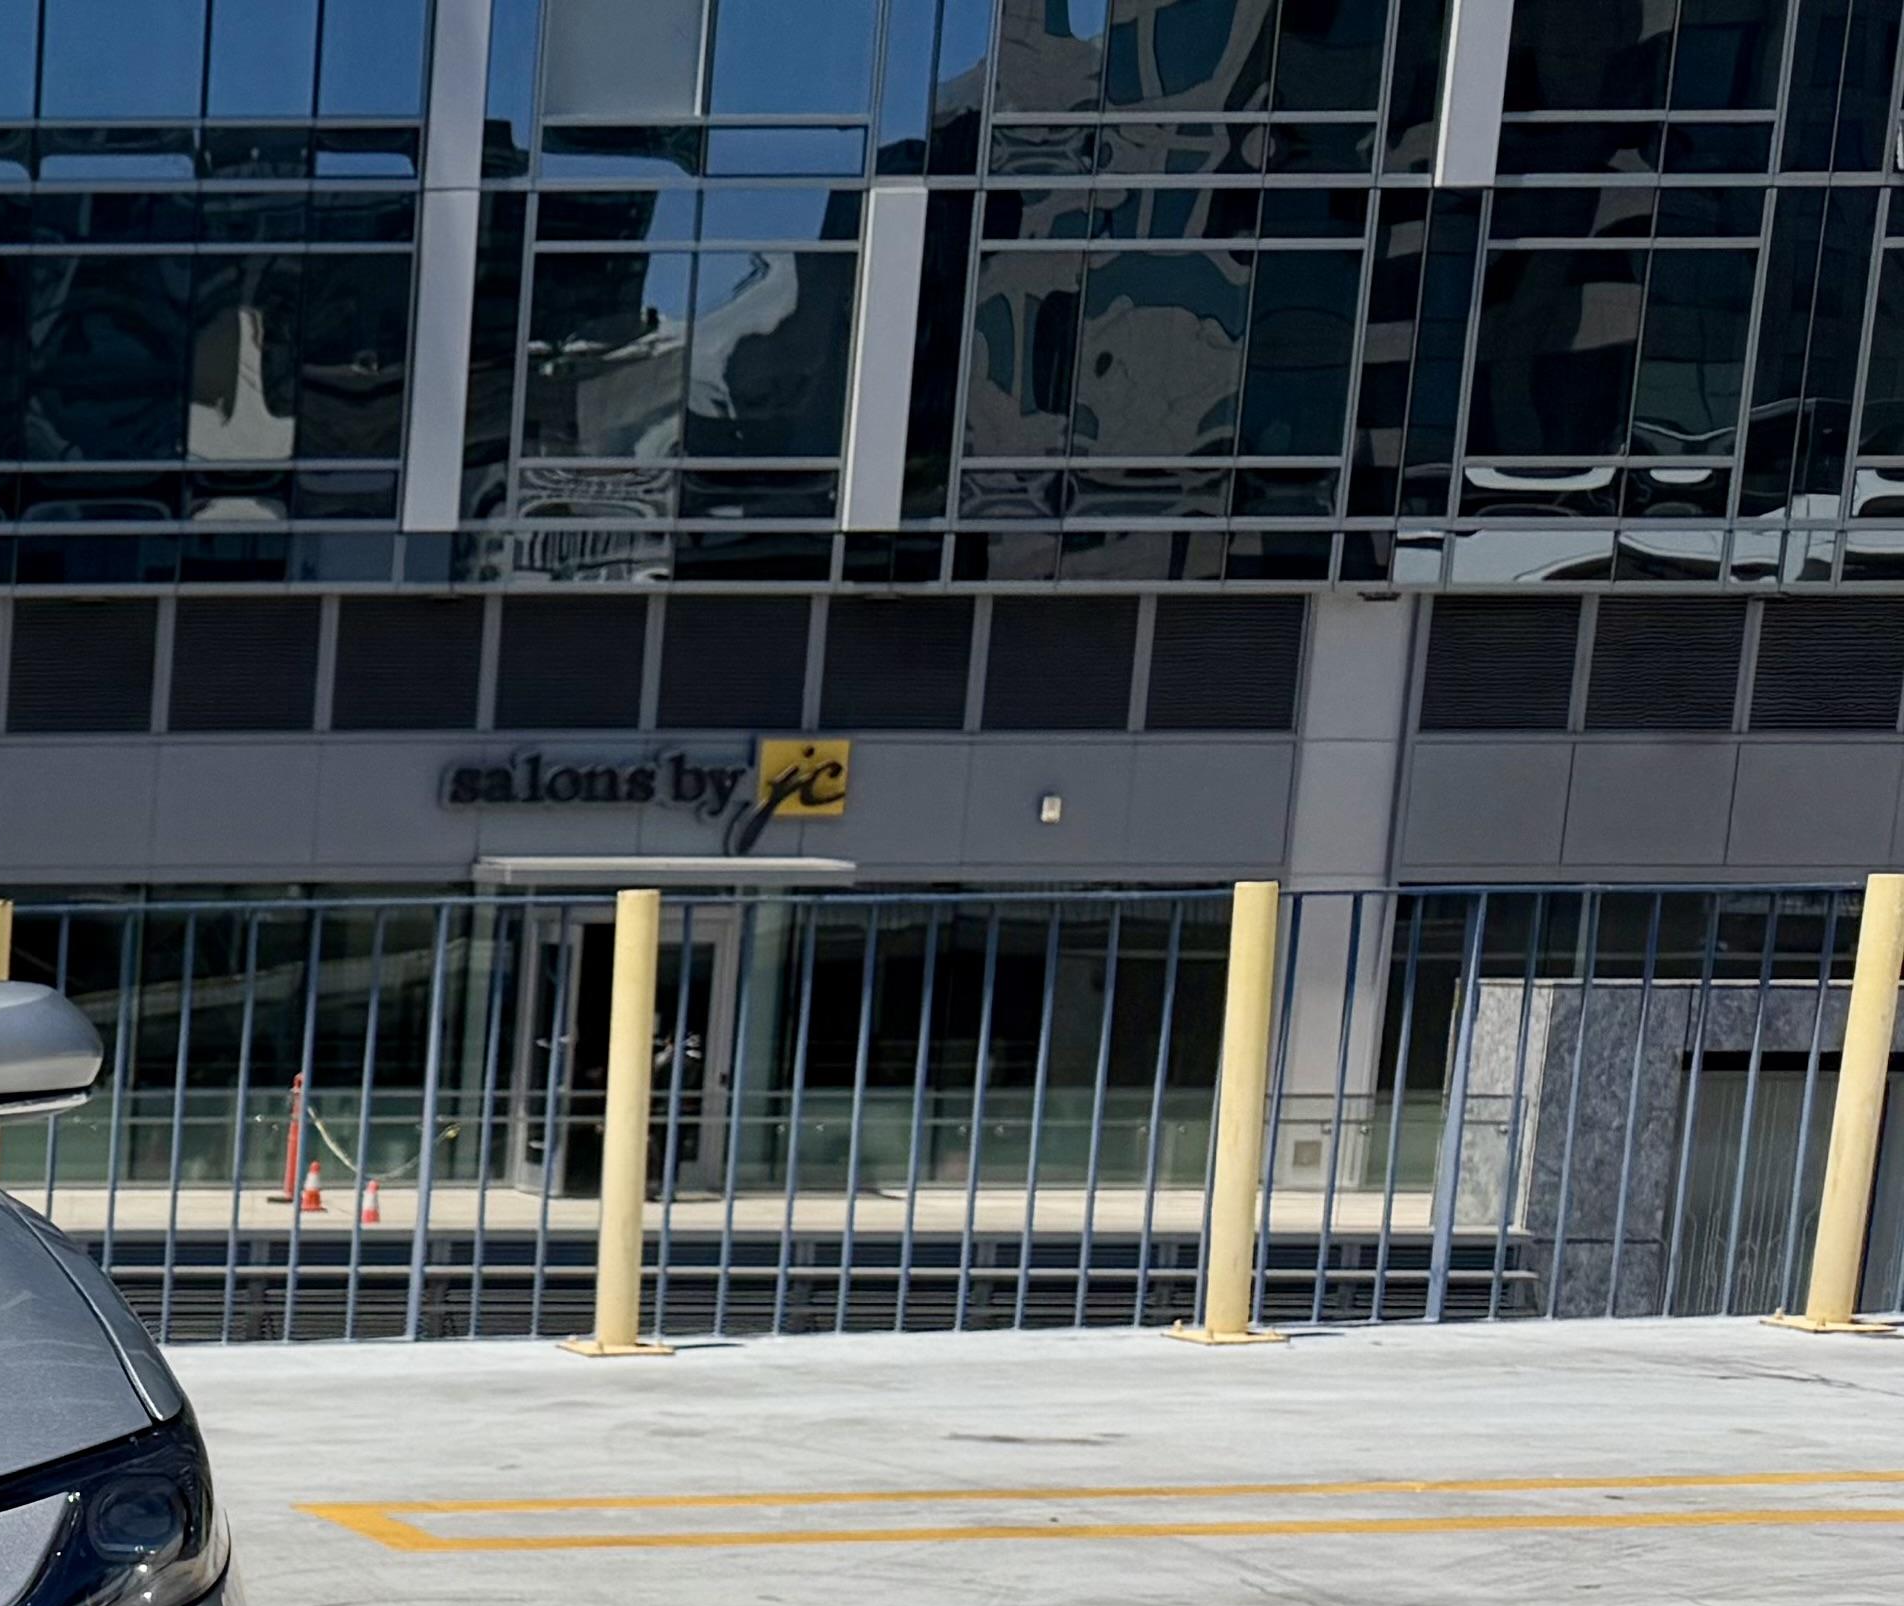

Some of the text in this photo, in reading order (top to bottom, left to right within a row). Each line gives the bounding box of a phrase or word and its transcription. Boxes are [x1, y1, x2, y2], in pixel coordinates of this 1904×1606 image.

[448, 744, 847, 857] salons by jc
